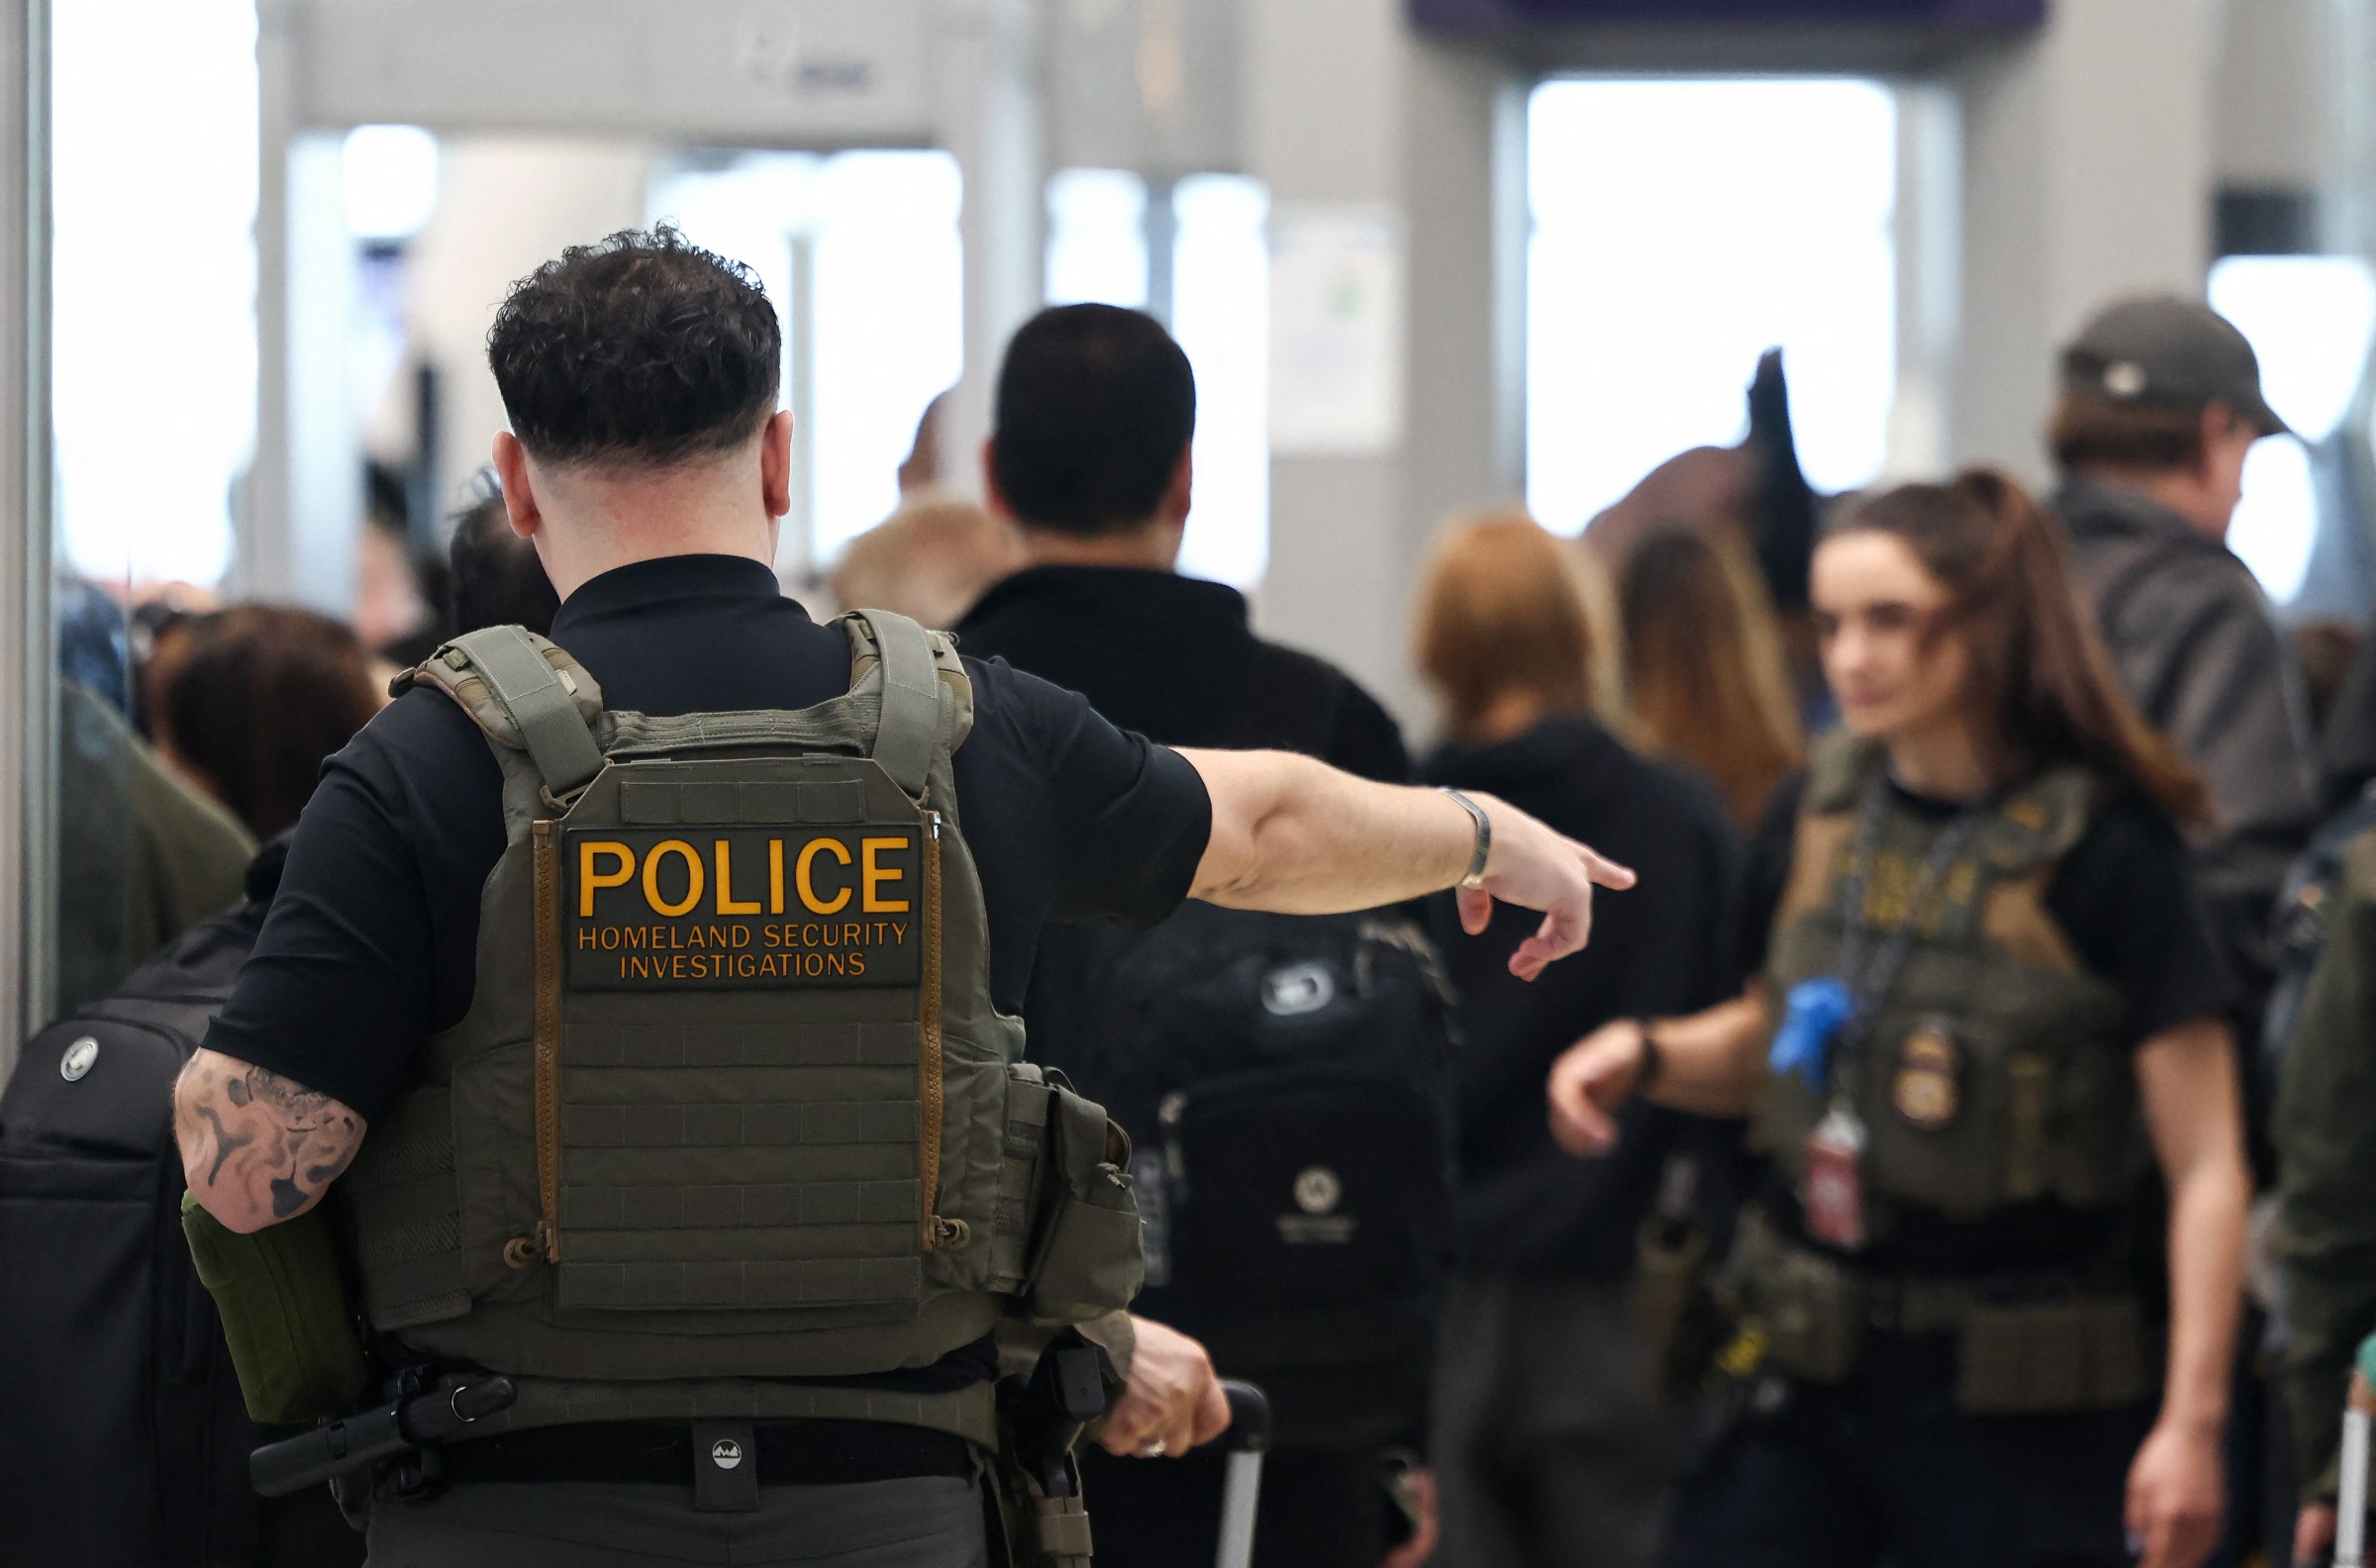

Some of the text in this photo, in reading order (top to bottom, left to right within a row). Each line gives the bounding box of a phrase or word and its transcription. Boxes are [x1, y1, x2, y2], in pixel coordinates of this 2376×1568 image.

[579, 836, 910, 917] POLICE
[578, 922, 908, 950] HOMELAND SECURITY
[620, 951, 866, 979] INVESTIGATIONS
